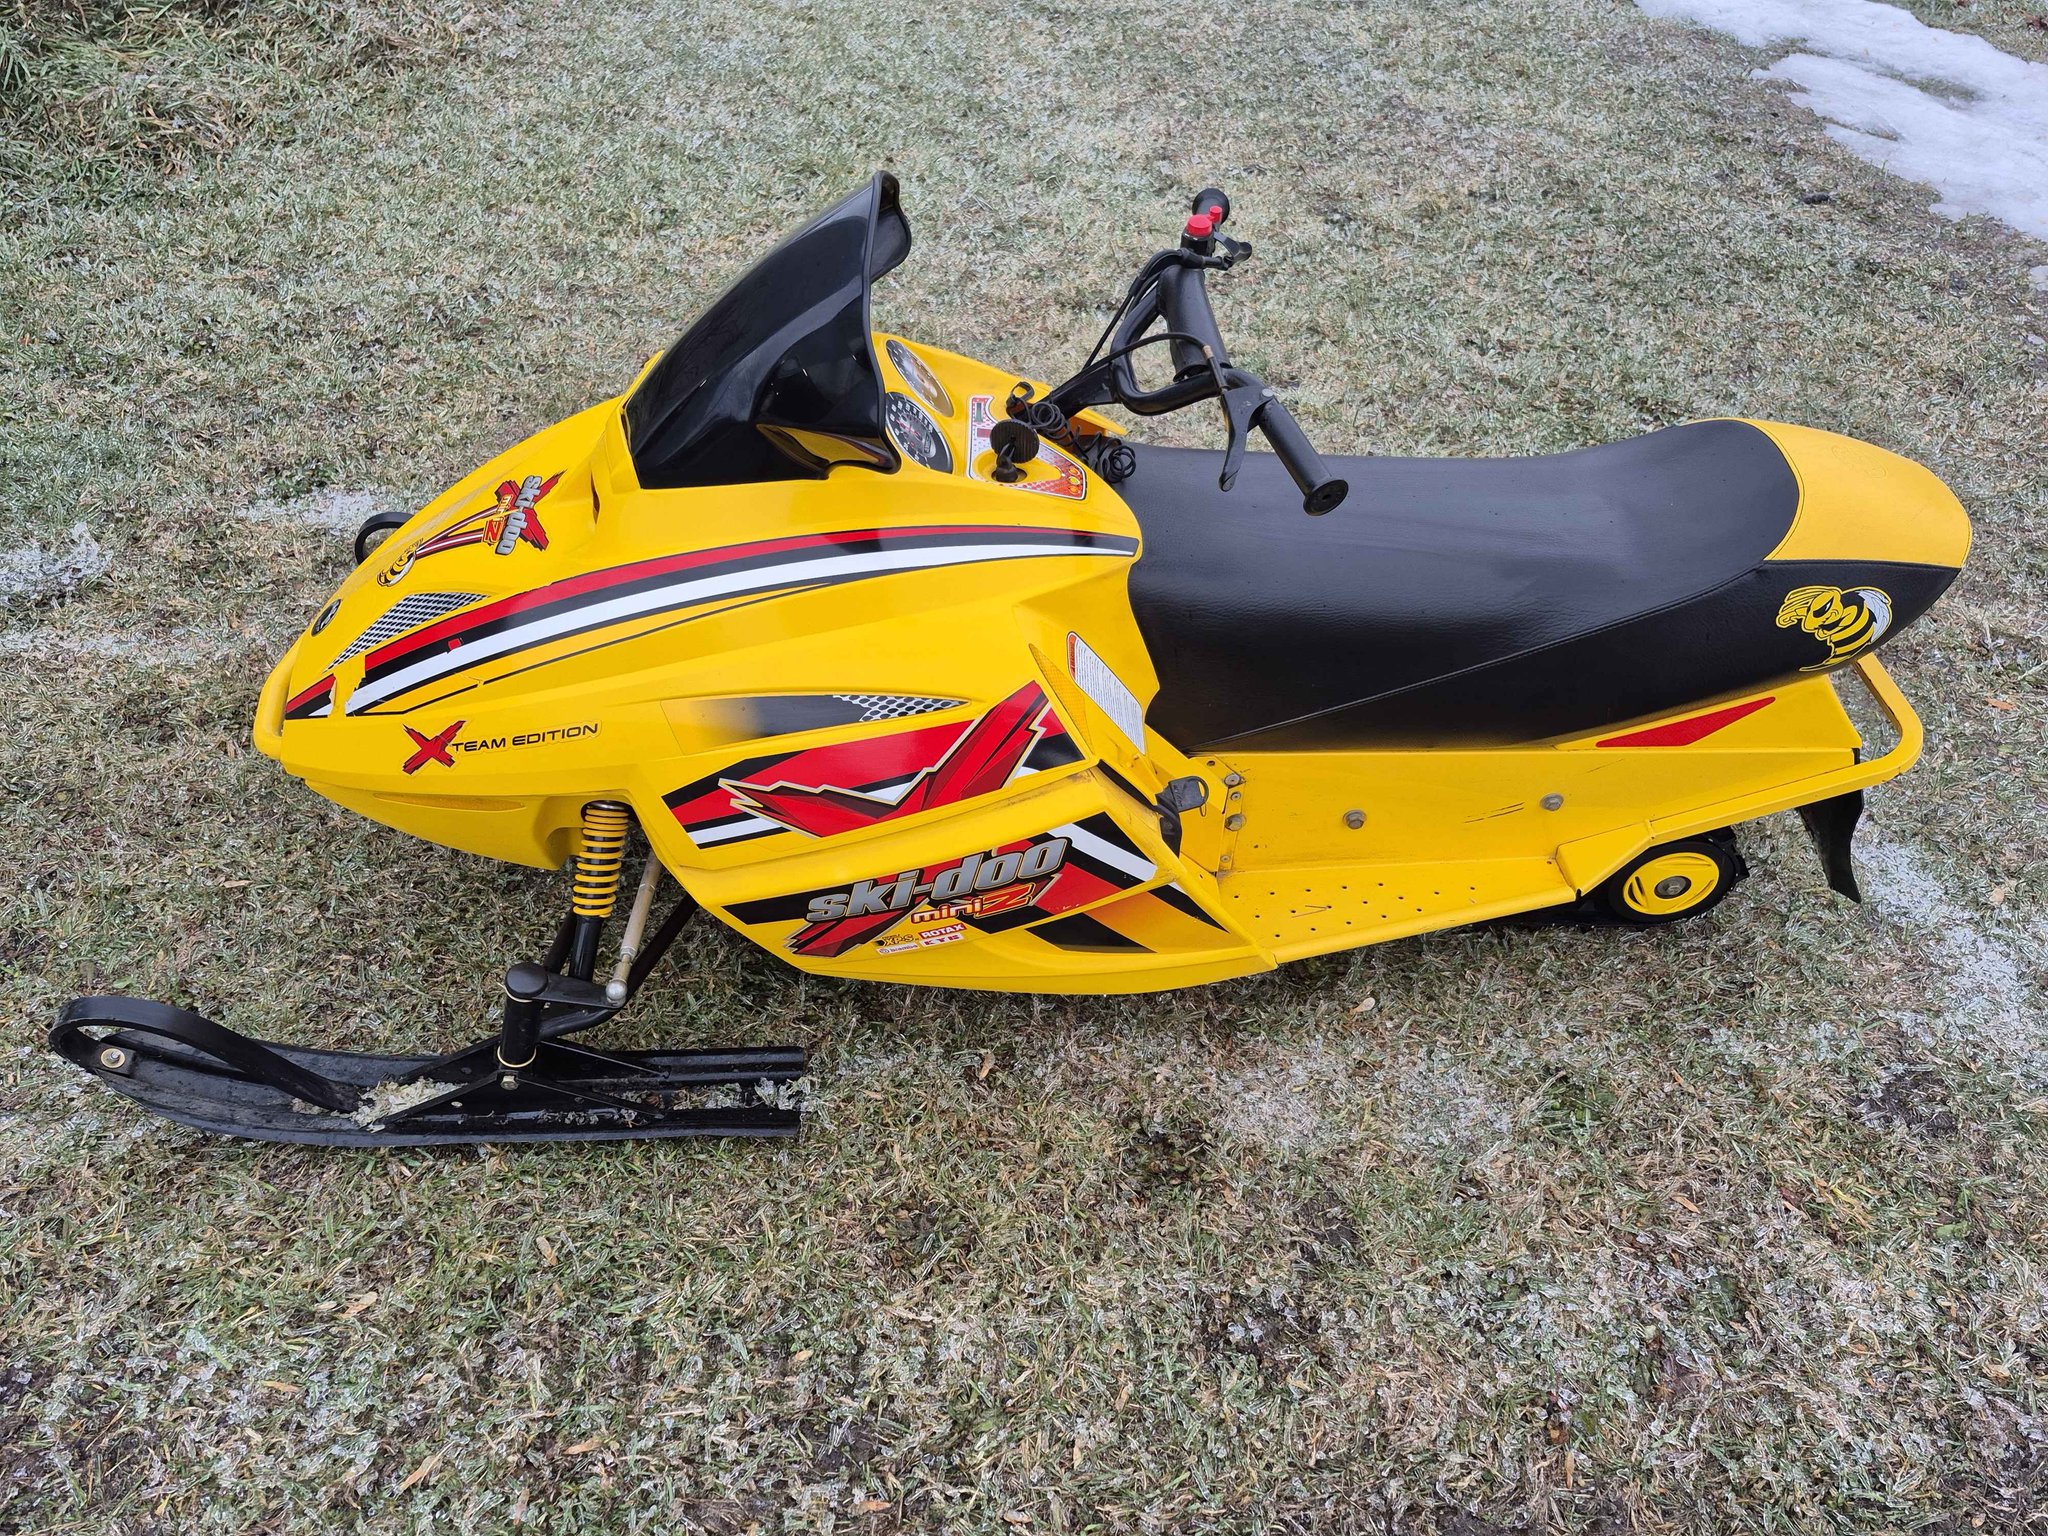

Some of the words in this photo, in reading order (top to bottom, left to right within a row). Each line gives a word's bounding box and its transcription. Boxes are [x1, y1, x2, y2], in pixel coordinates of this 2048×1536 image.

[496, 475, 542, 555] ski-doo
[452, 738, 506, 752] TEAM
[512, 723, 598, 746] EDITION
[807, 837, 1069, 921] ski-doo
[921, 924, 964, 938] ROTAX
